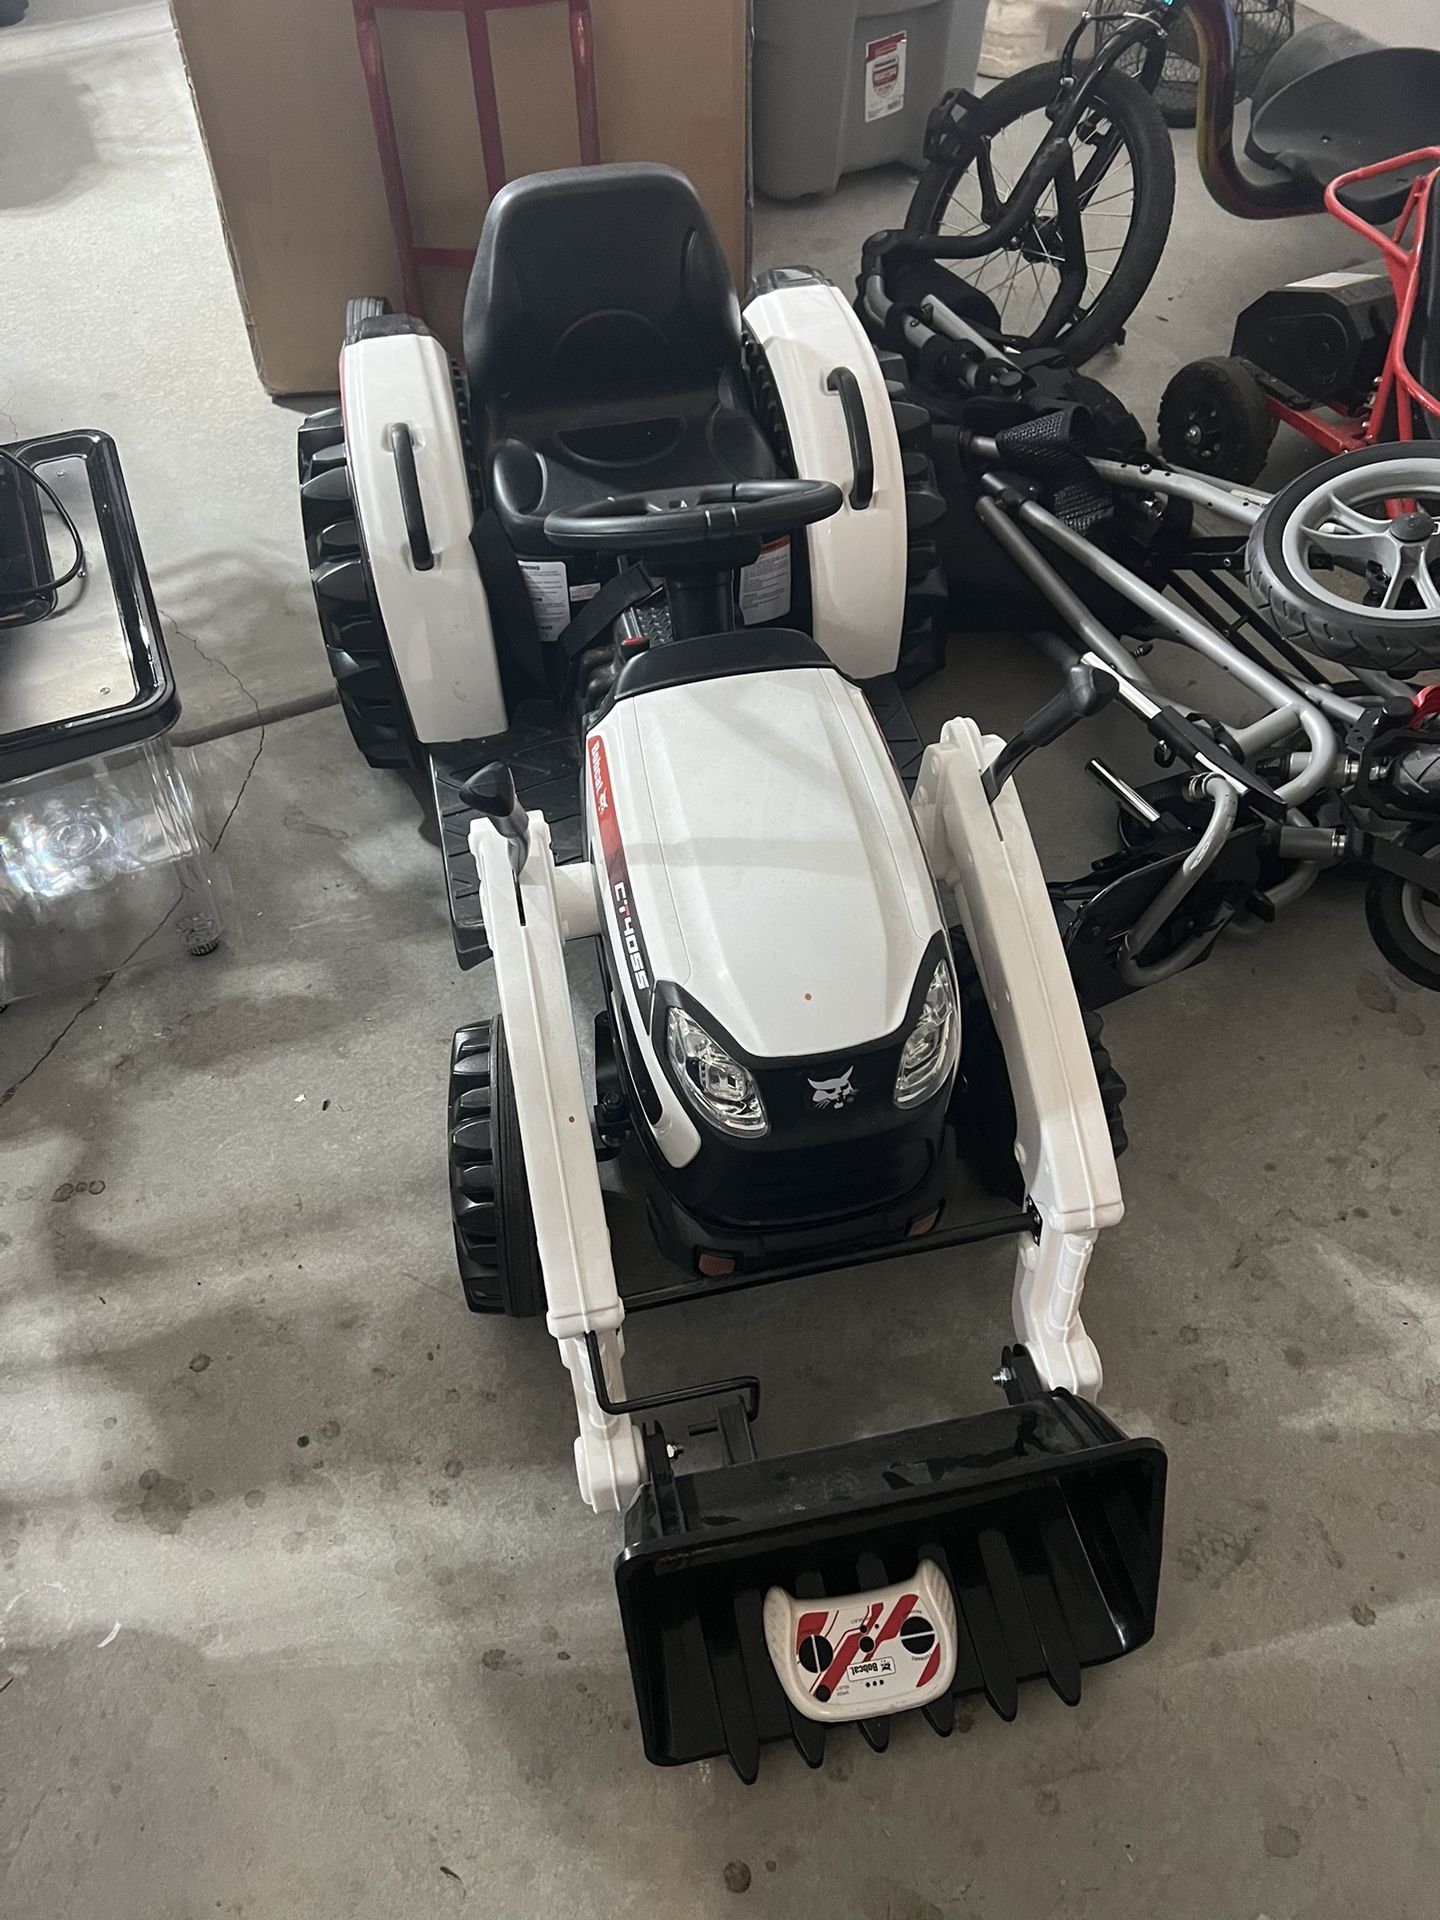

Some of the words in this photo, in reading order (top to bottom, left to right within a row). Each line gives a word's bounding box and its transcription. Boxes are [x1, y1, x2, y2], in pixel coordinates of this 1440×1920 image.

[591, 739, 604, 797] Bobcat
[614, 881, 650, 990] CT4055
[850, 1661, 879, 1676] Bobcat
